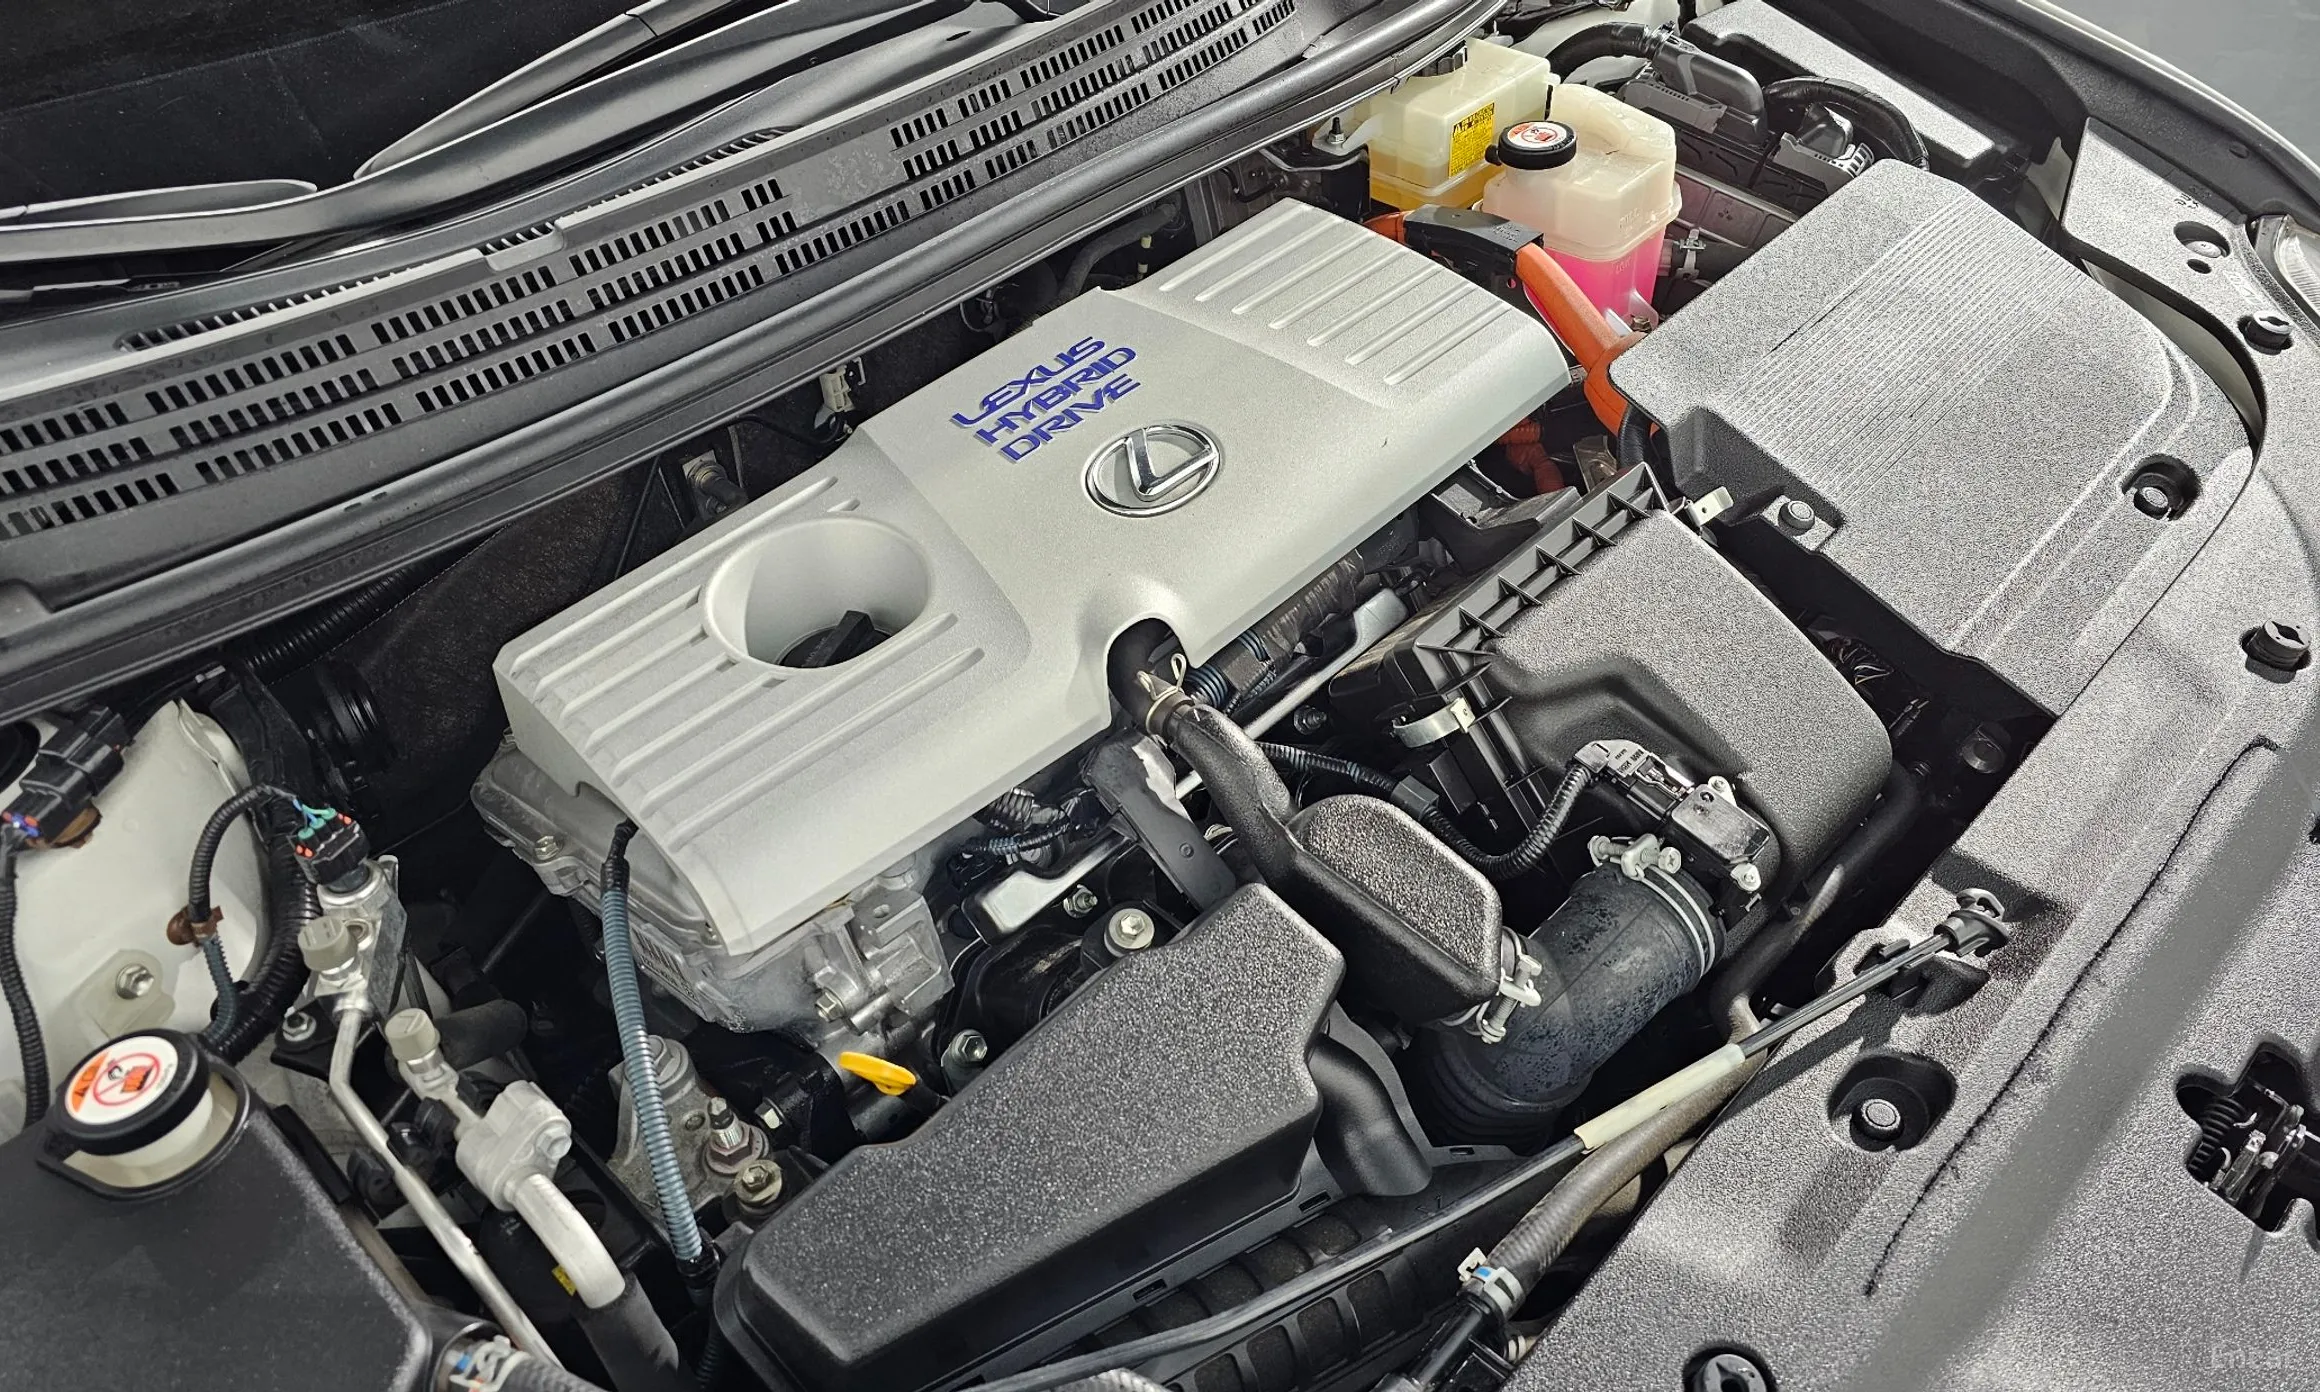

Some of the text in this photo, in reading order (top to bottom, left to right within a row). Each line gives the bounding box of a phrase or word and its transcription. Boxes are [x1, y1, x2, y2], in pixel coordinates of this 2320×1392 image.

[951, 336, 1106, 427] LEXUS
[975, 347, 1137, 446] HYBRID
[1000, 373, 1141, 464] DRIVE
